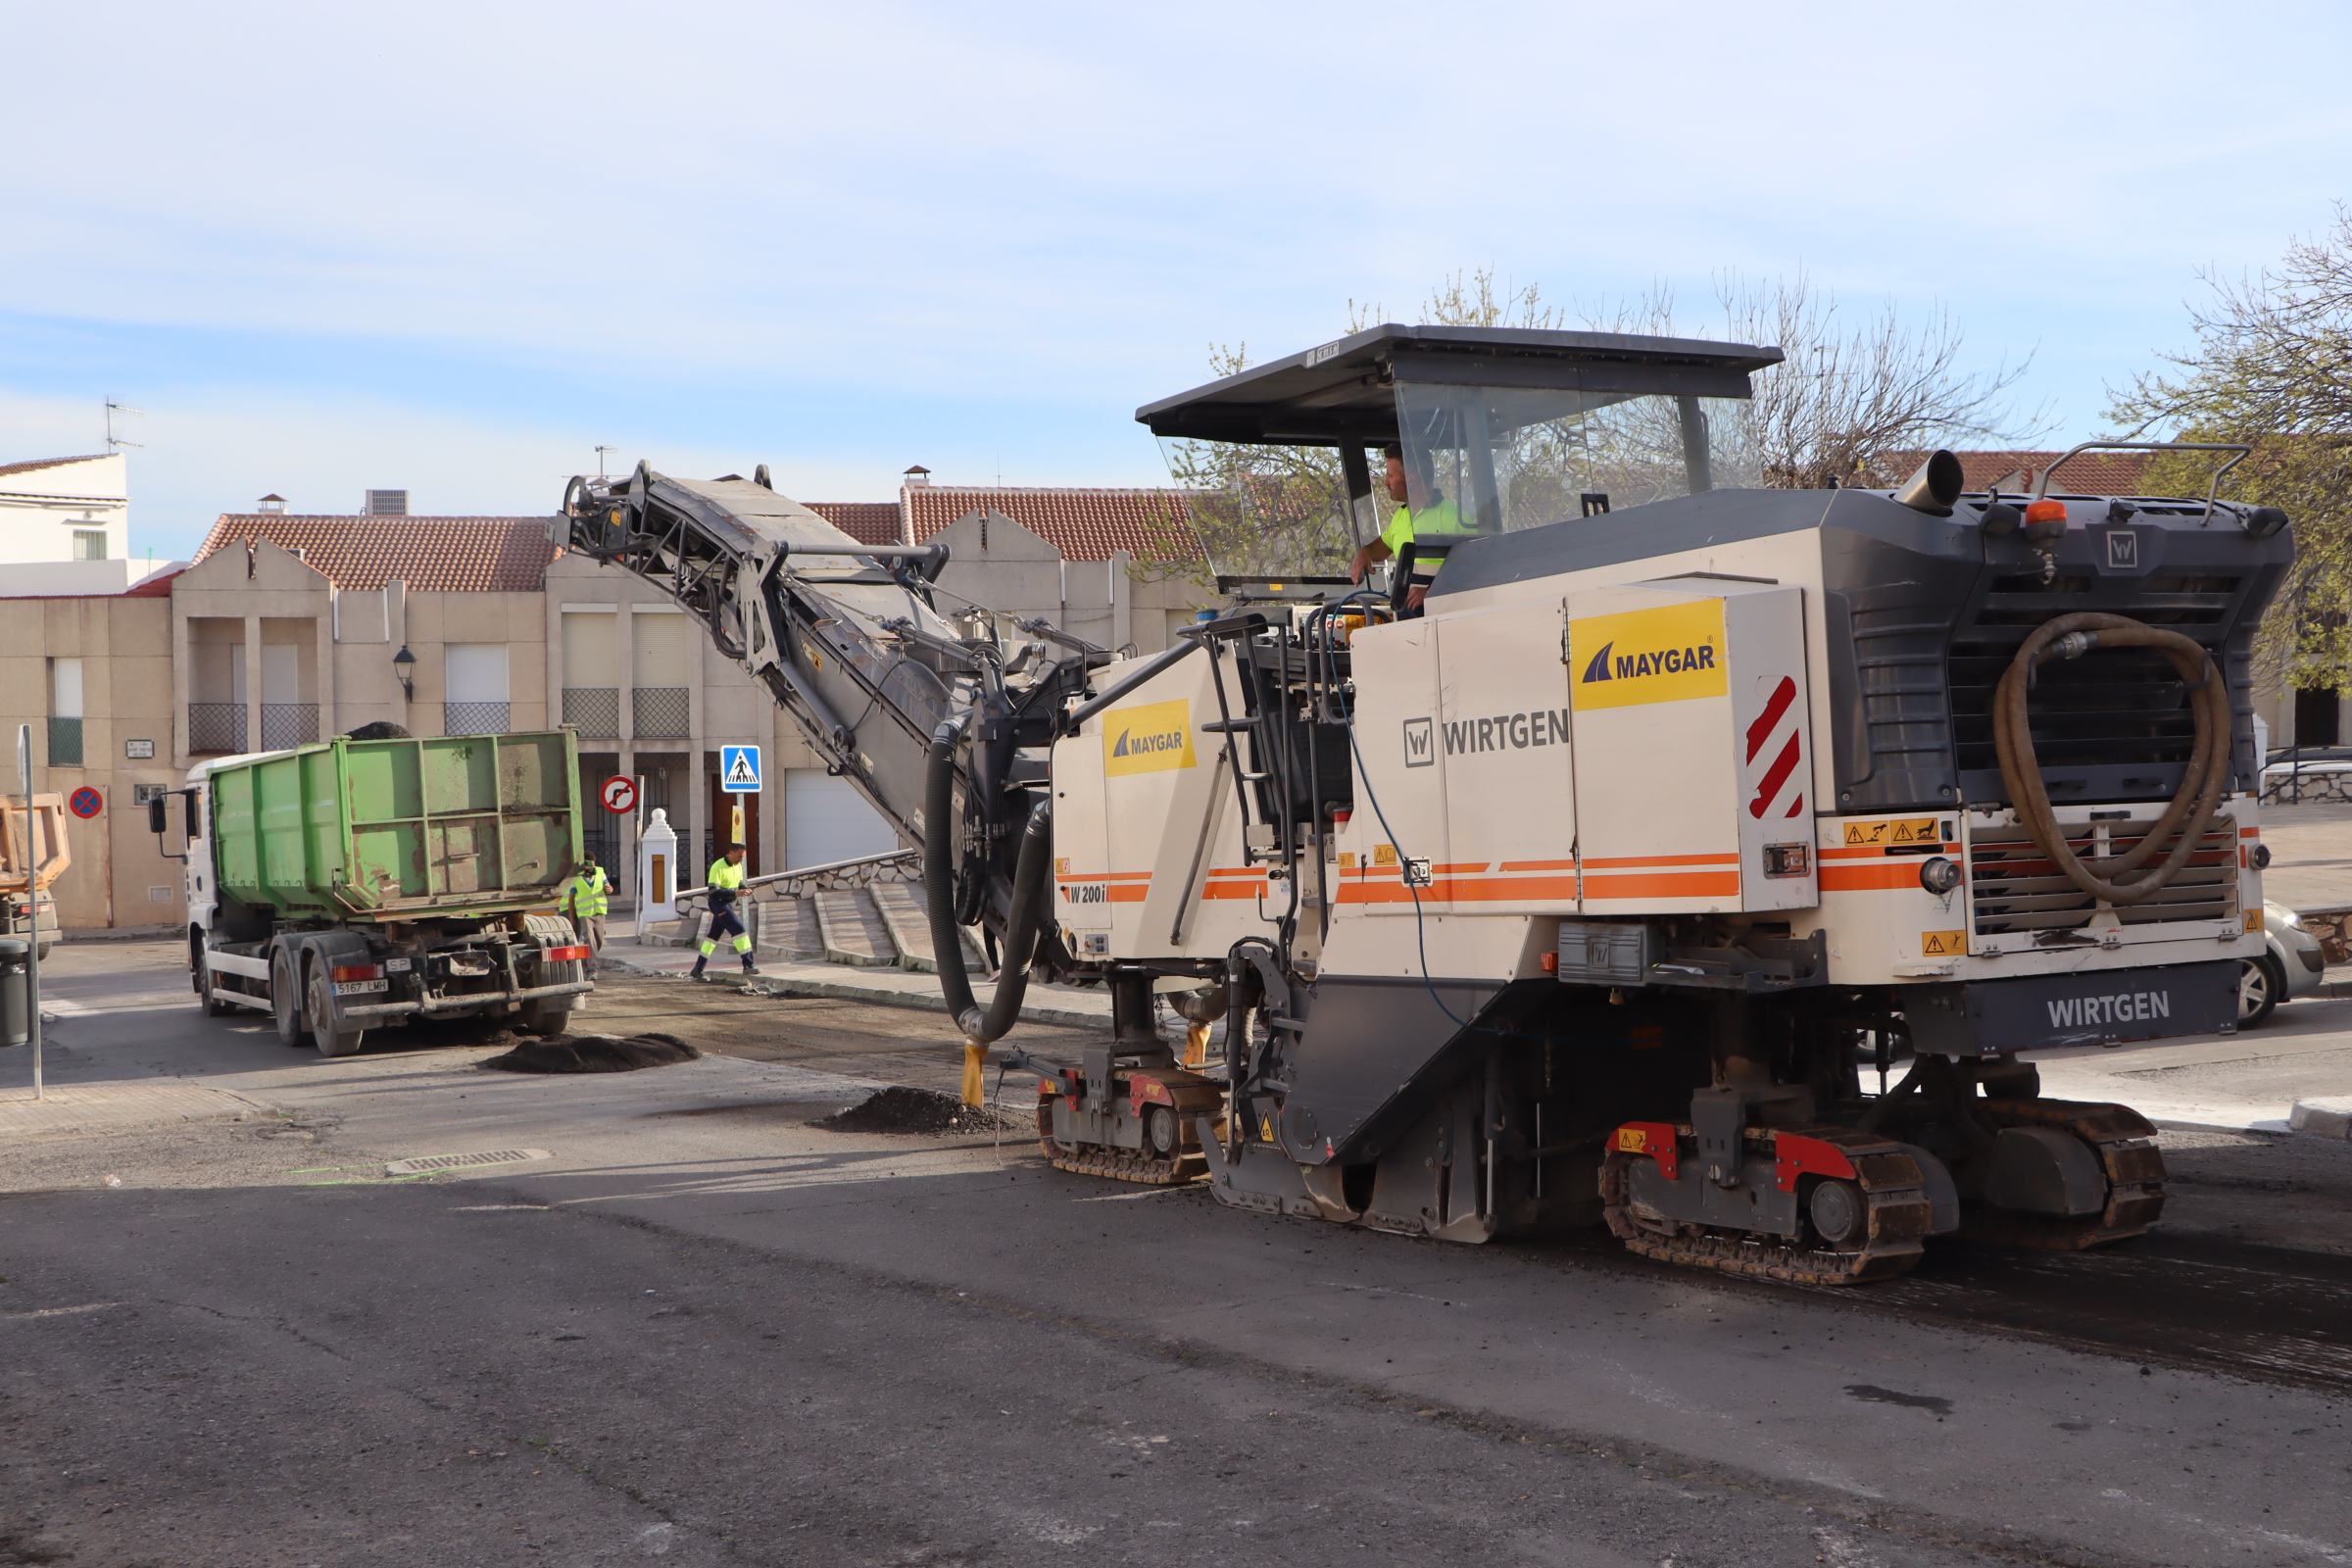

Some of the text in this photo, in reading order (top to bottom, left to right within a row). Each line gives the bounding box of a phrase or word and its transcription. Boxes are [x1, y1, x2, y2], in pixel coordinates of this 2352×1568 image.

[1616, 645, 1716, 680] MAYGAR
[1130, 731, 1183, 756] MAYGAR
[1442, 709, 1570, 756] WIRTGEN
[1071, 884, 1105, 904] W 200i
[389, 959, 408, 970] SP
[338, 980, 386, 994] 5167 LMH
[2047, 991, 2171, 1028] WIRTGEN
